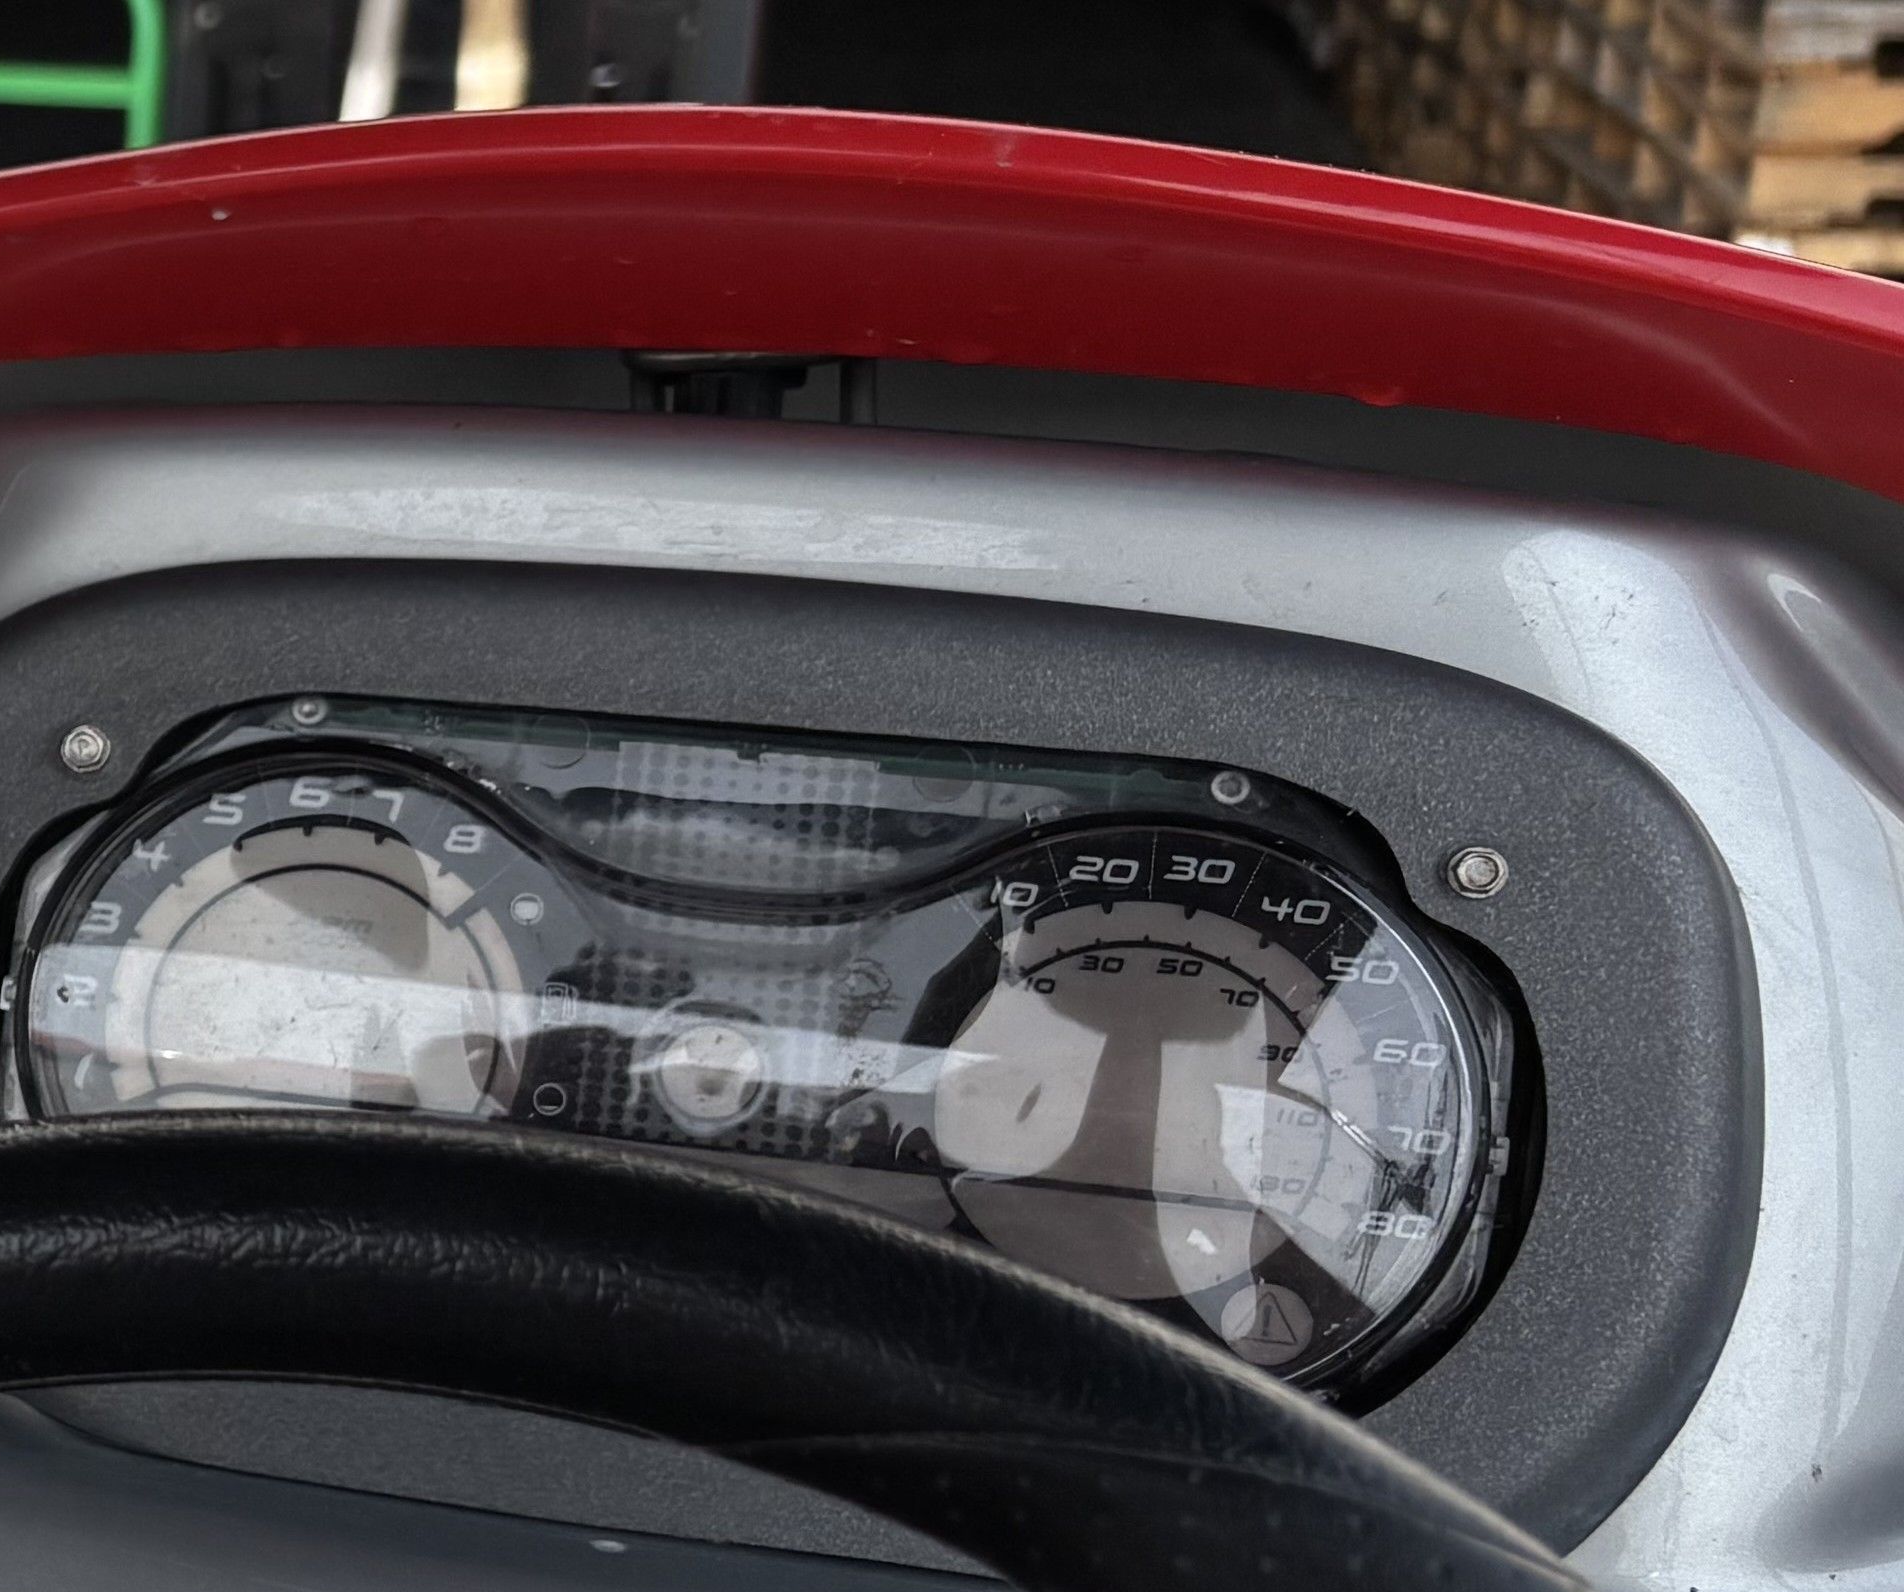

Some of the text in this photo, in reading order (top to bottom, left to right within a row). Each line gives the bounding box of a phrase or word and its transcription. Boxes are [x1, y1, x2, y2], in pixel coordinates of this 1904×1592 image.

[81, 899, 123, 934] 3
[132, 837, 173, 873] 4
[203, 793, 247, 826] 5
[289, 777, 332, 808] 6
[372, 789, 404, 822] 7
[443, 824, 487, 854] 8
[1078, 955, 1125, 973] 30
[1156, 958, 1204, 977] 50
[1024, 976, 1056, 995] 10
[1220, 988, 1260, 1008] 70
[991, 855, 1452, 1240] 10 20 30 40 50 60 70 80
[1257, 1044, 1304, 1064] 90
[1276, 1108, 1319, 1128] 110
